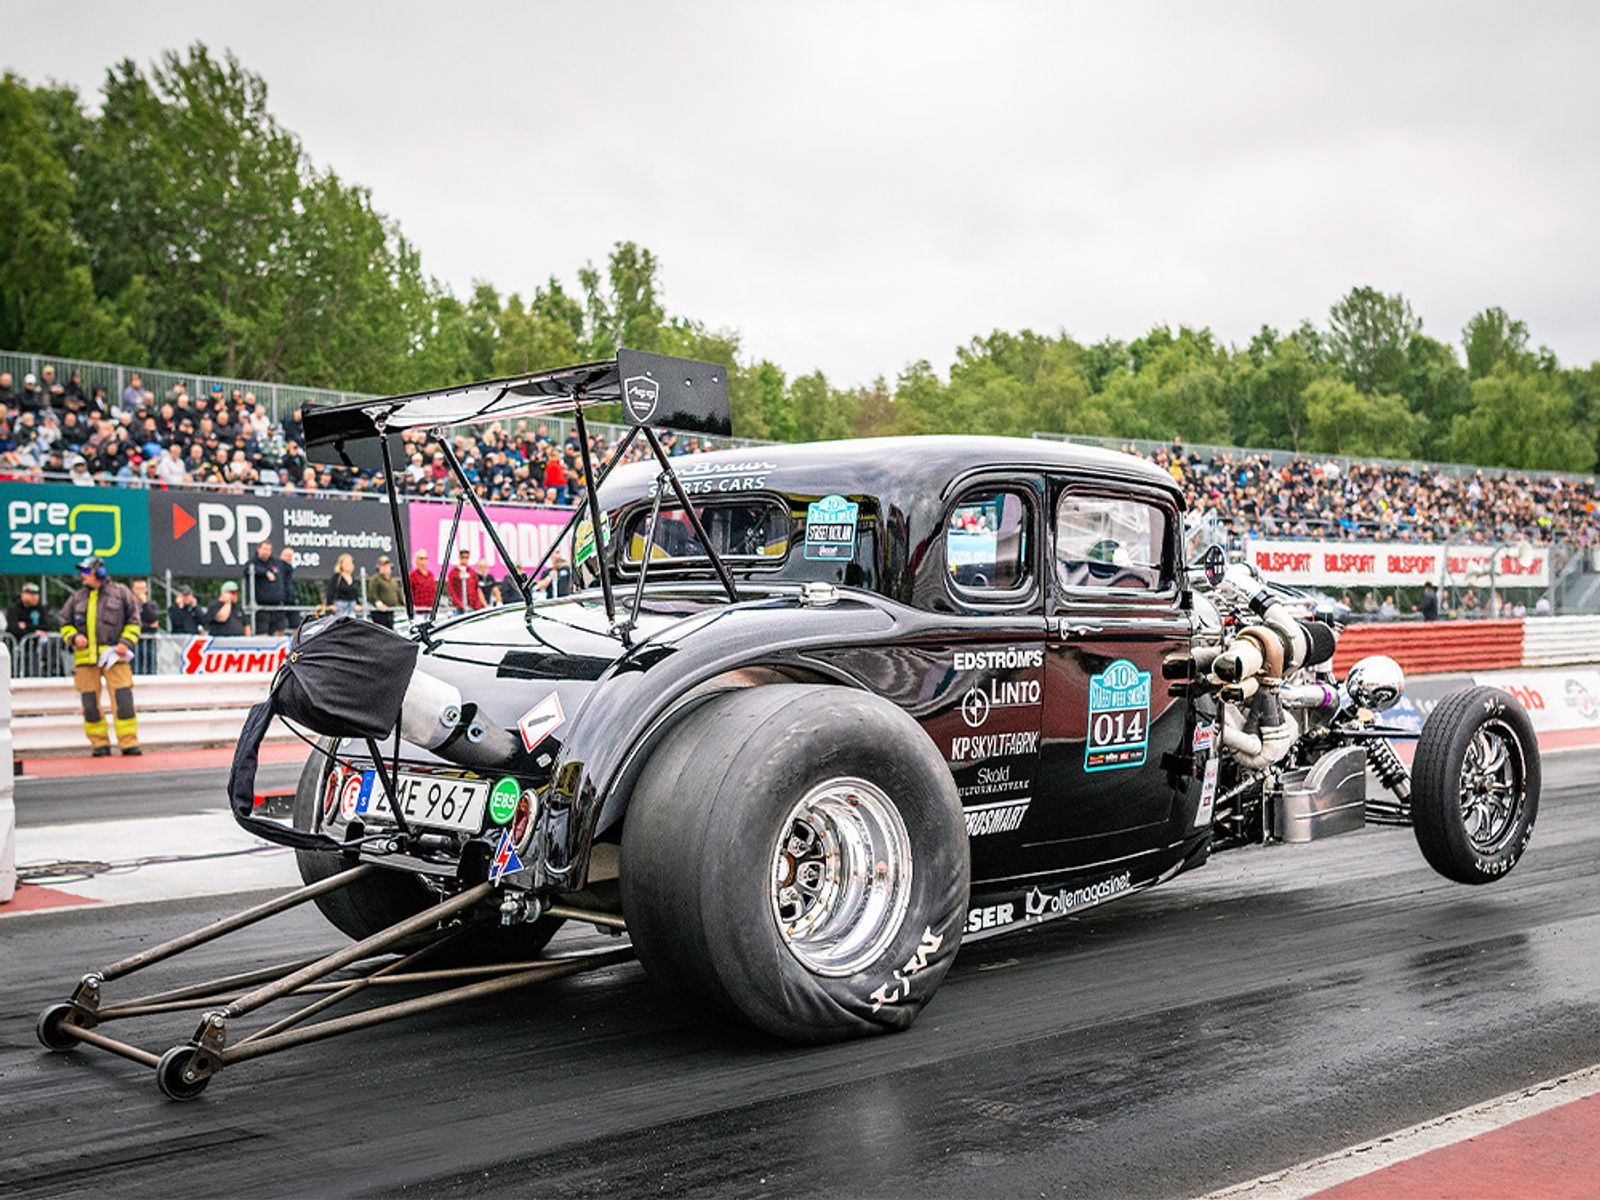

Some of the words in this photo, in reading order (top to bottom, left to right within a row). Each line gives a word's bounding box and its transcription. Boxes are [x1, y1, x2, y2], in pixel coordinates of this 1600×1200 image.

[718, 477, 766, 491] CARS
[8, 501, 69, 530] pre
[283, 509, 332, 528] Hållbar
[10, 532, 92, 557] zero
[199, 503, 272, 566] RP
[283, 528, 392, 552] kontorsinredning
[290, 551, 320, 569] p.se
[1256, 551, 1311, 574] BILSPORT
[1324, 554, 1376, 574] BILSPORT
[1387, 555, 1436, 575] BILSPORT
[1113, 667, 1129, 687] 10
[991, 678, 1041, 704] LINTO
[1094, 712, 1143, 746] 014
[951, 737, 970, 760] KP
[426, 783, 475, 823] 967
[493, 791, 517, 808] E85
[962, 902, 1015, 933] SER
